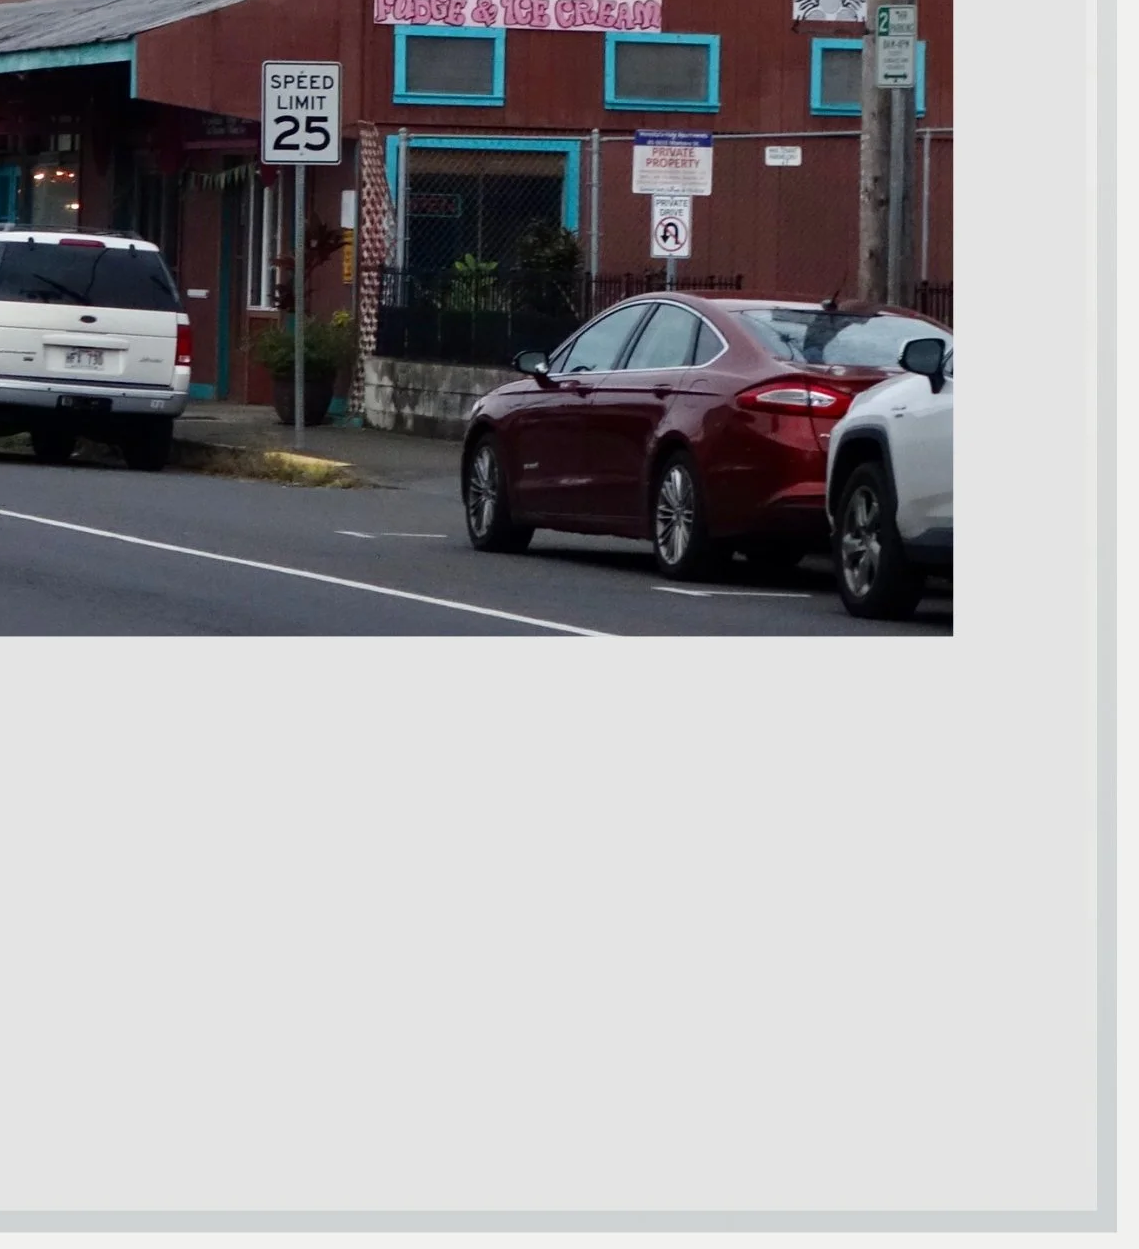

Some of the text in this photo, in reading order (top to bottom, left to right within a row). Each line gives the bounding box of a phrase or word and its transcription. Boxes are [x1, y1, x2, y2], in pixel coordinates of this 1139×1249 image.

[879, 11, 889, 33] 2
[270, 74, 334, 90] SPEED
[277, 95, 327, 111] LIMIT
[273, 115, 331, 151] 25
[652, 147, 696, 158] PRIVATE
[646, 158, 700, 169] PROPERTY
[656, 199, 688, 208] PRIVATE
[660, 209, 684, 217] DRIVE
